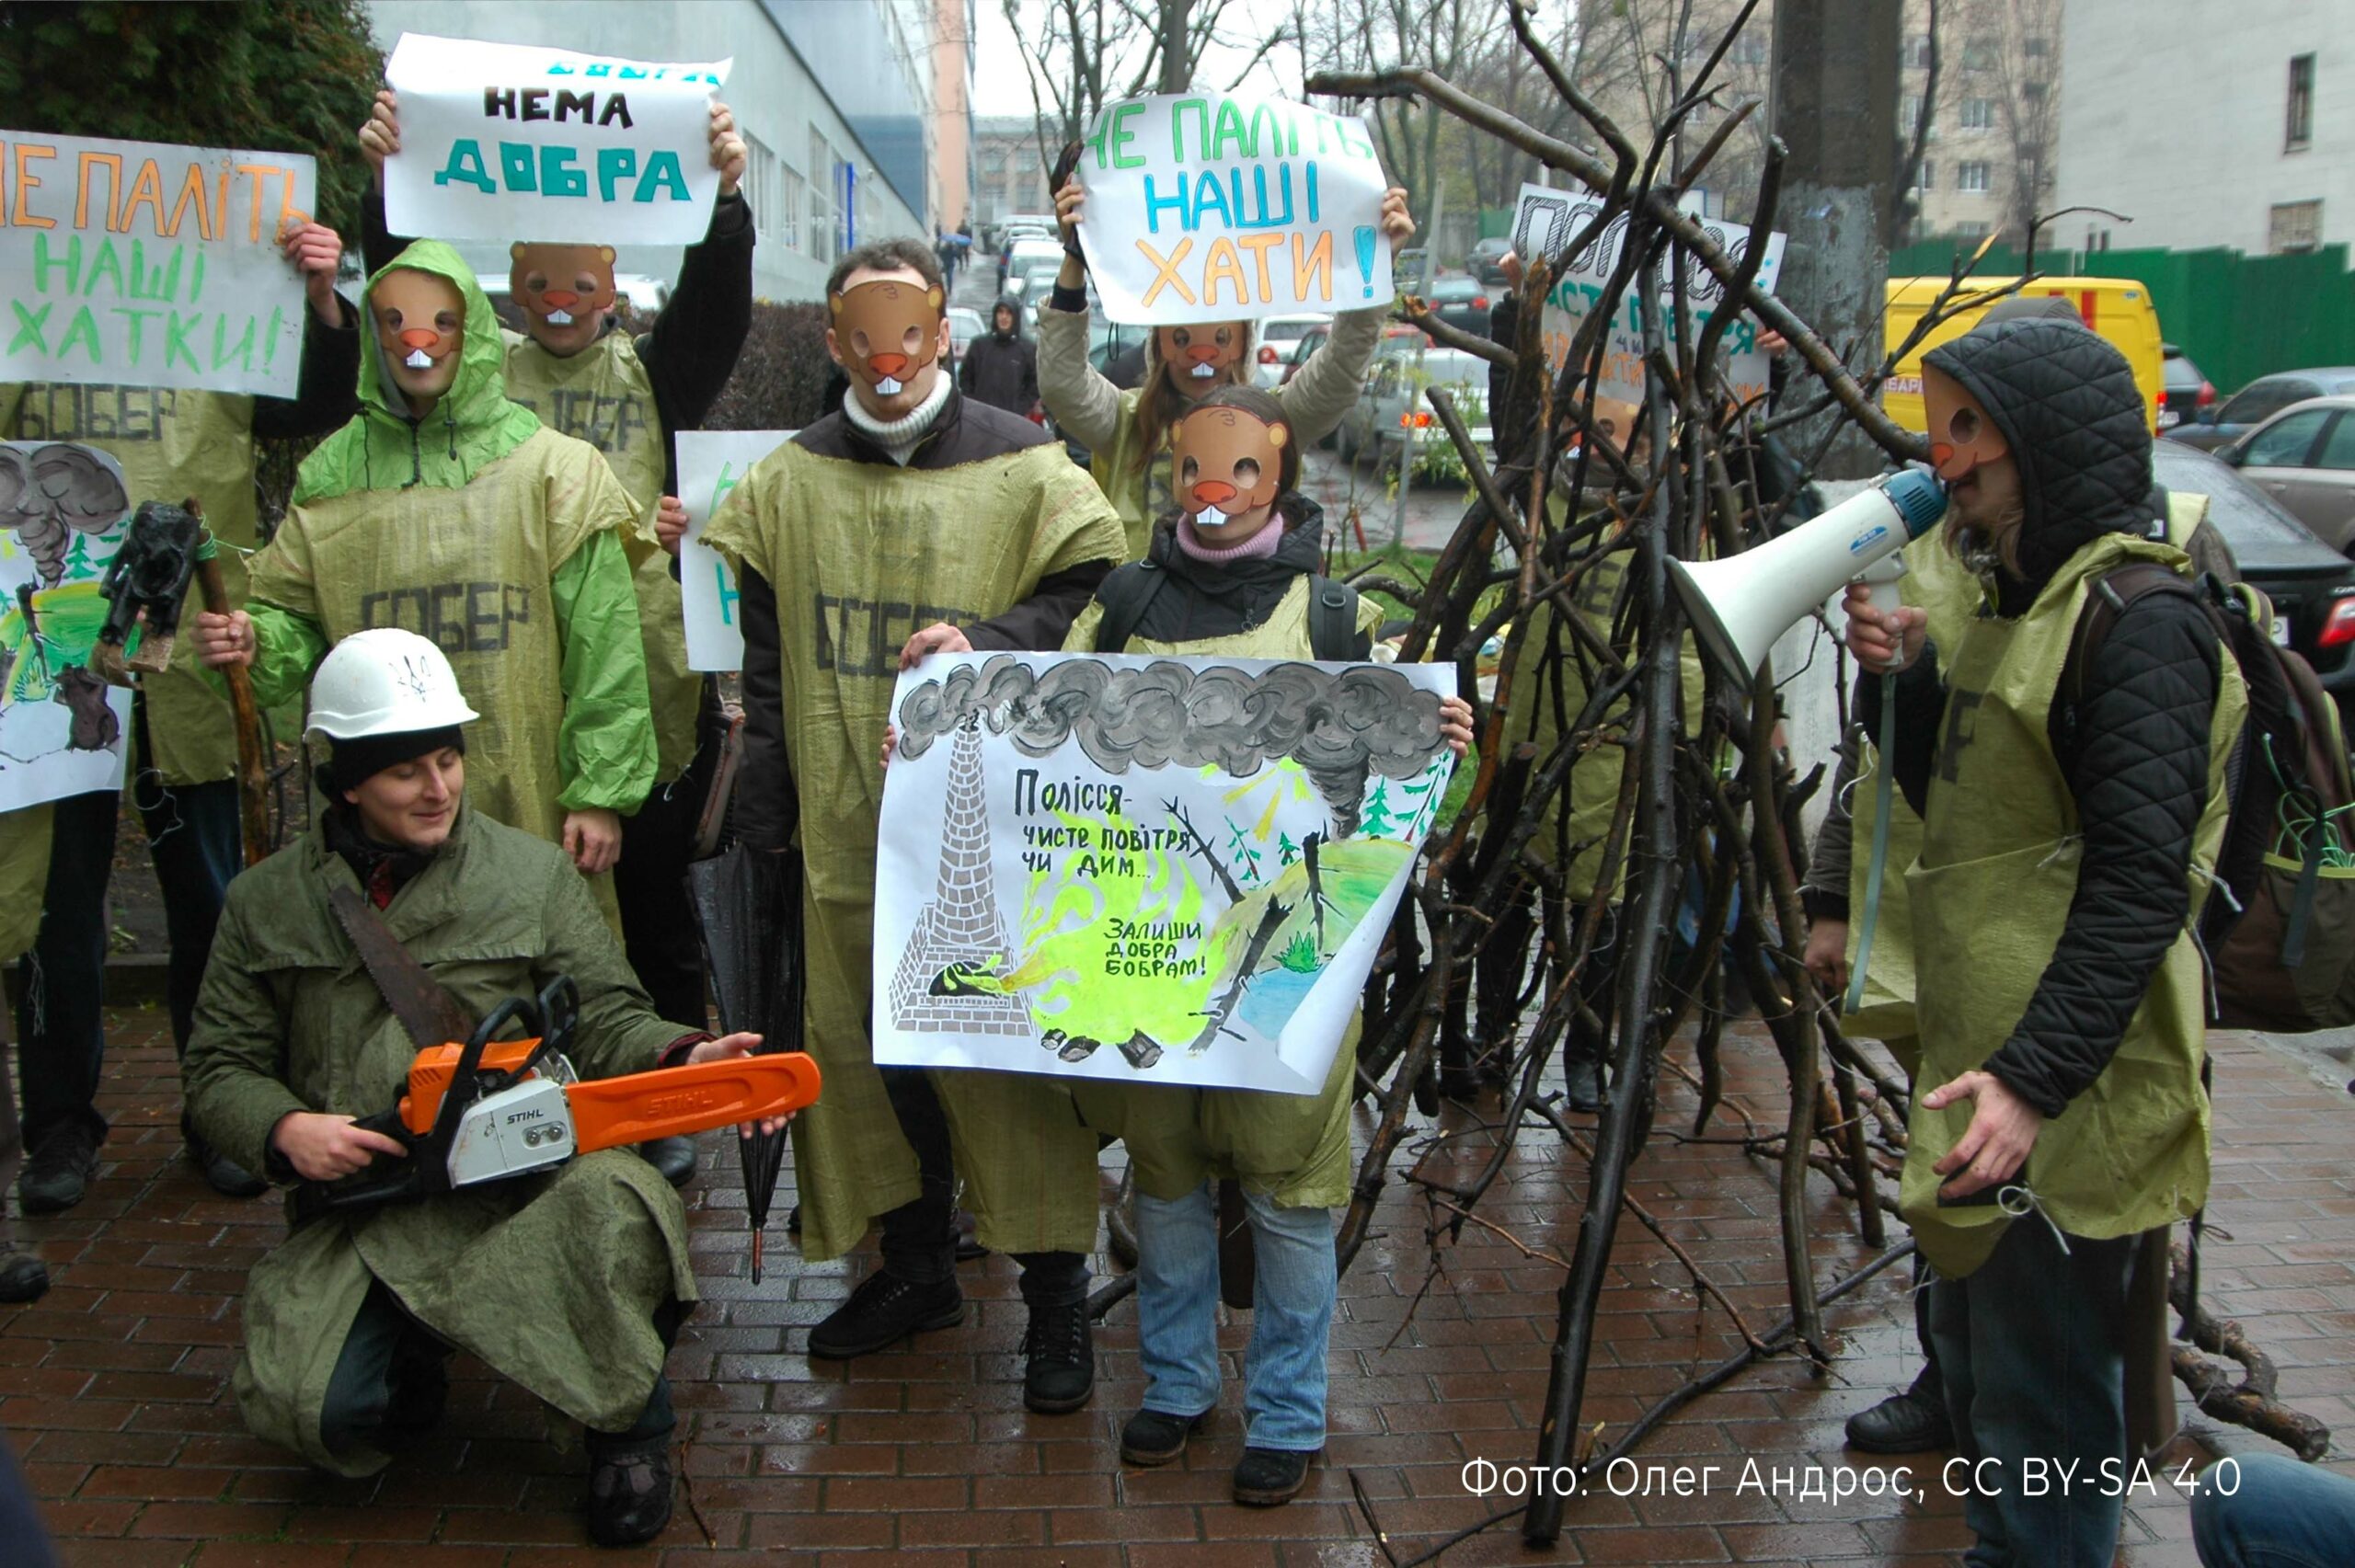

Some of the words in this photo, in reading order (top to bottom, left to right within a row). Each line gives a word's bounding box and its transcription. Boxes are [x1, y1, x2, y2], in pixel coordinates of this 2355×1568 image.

[483, 86, 634, 129] НЕМА
[1172, 97, 1373, 164] ПАЛІТЬ
[0, 142, 57, 230] Е
[434, 139, 693, 202] ДОБРА
[1143, 160, 1319, 234] НАШІ
[6, 298, 284, 375] ХАТКИ!
[1104, 917, 1201, 941] ЗАЛИШИ
[1105, 942, 1178, 960] ДОБРА
[1105, 955, 1207, 979] БОБРАМ!
[506, 1108, 544, 1125] STIHL
